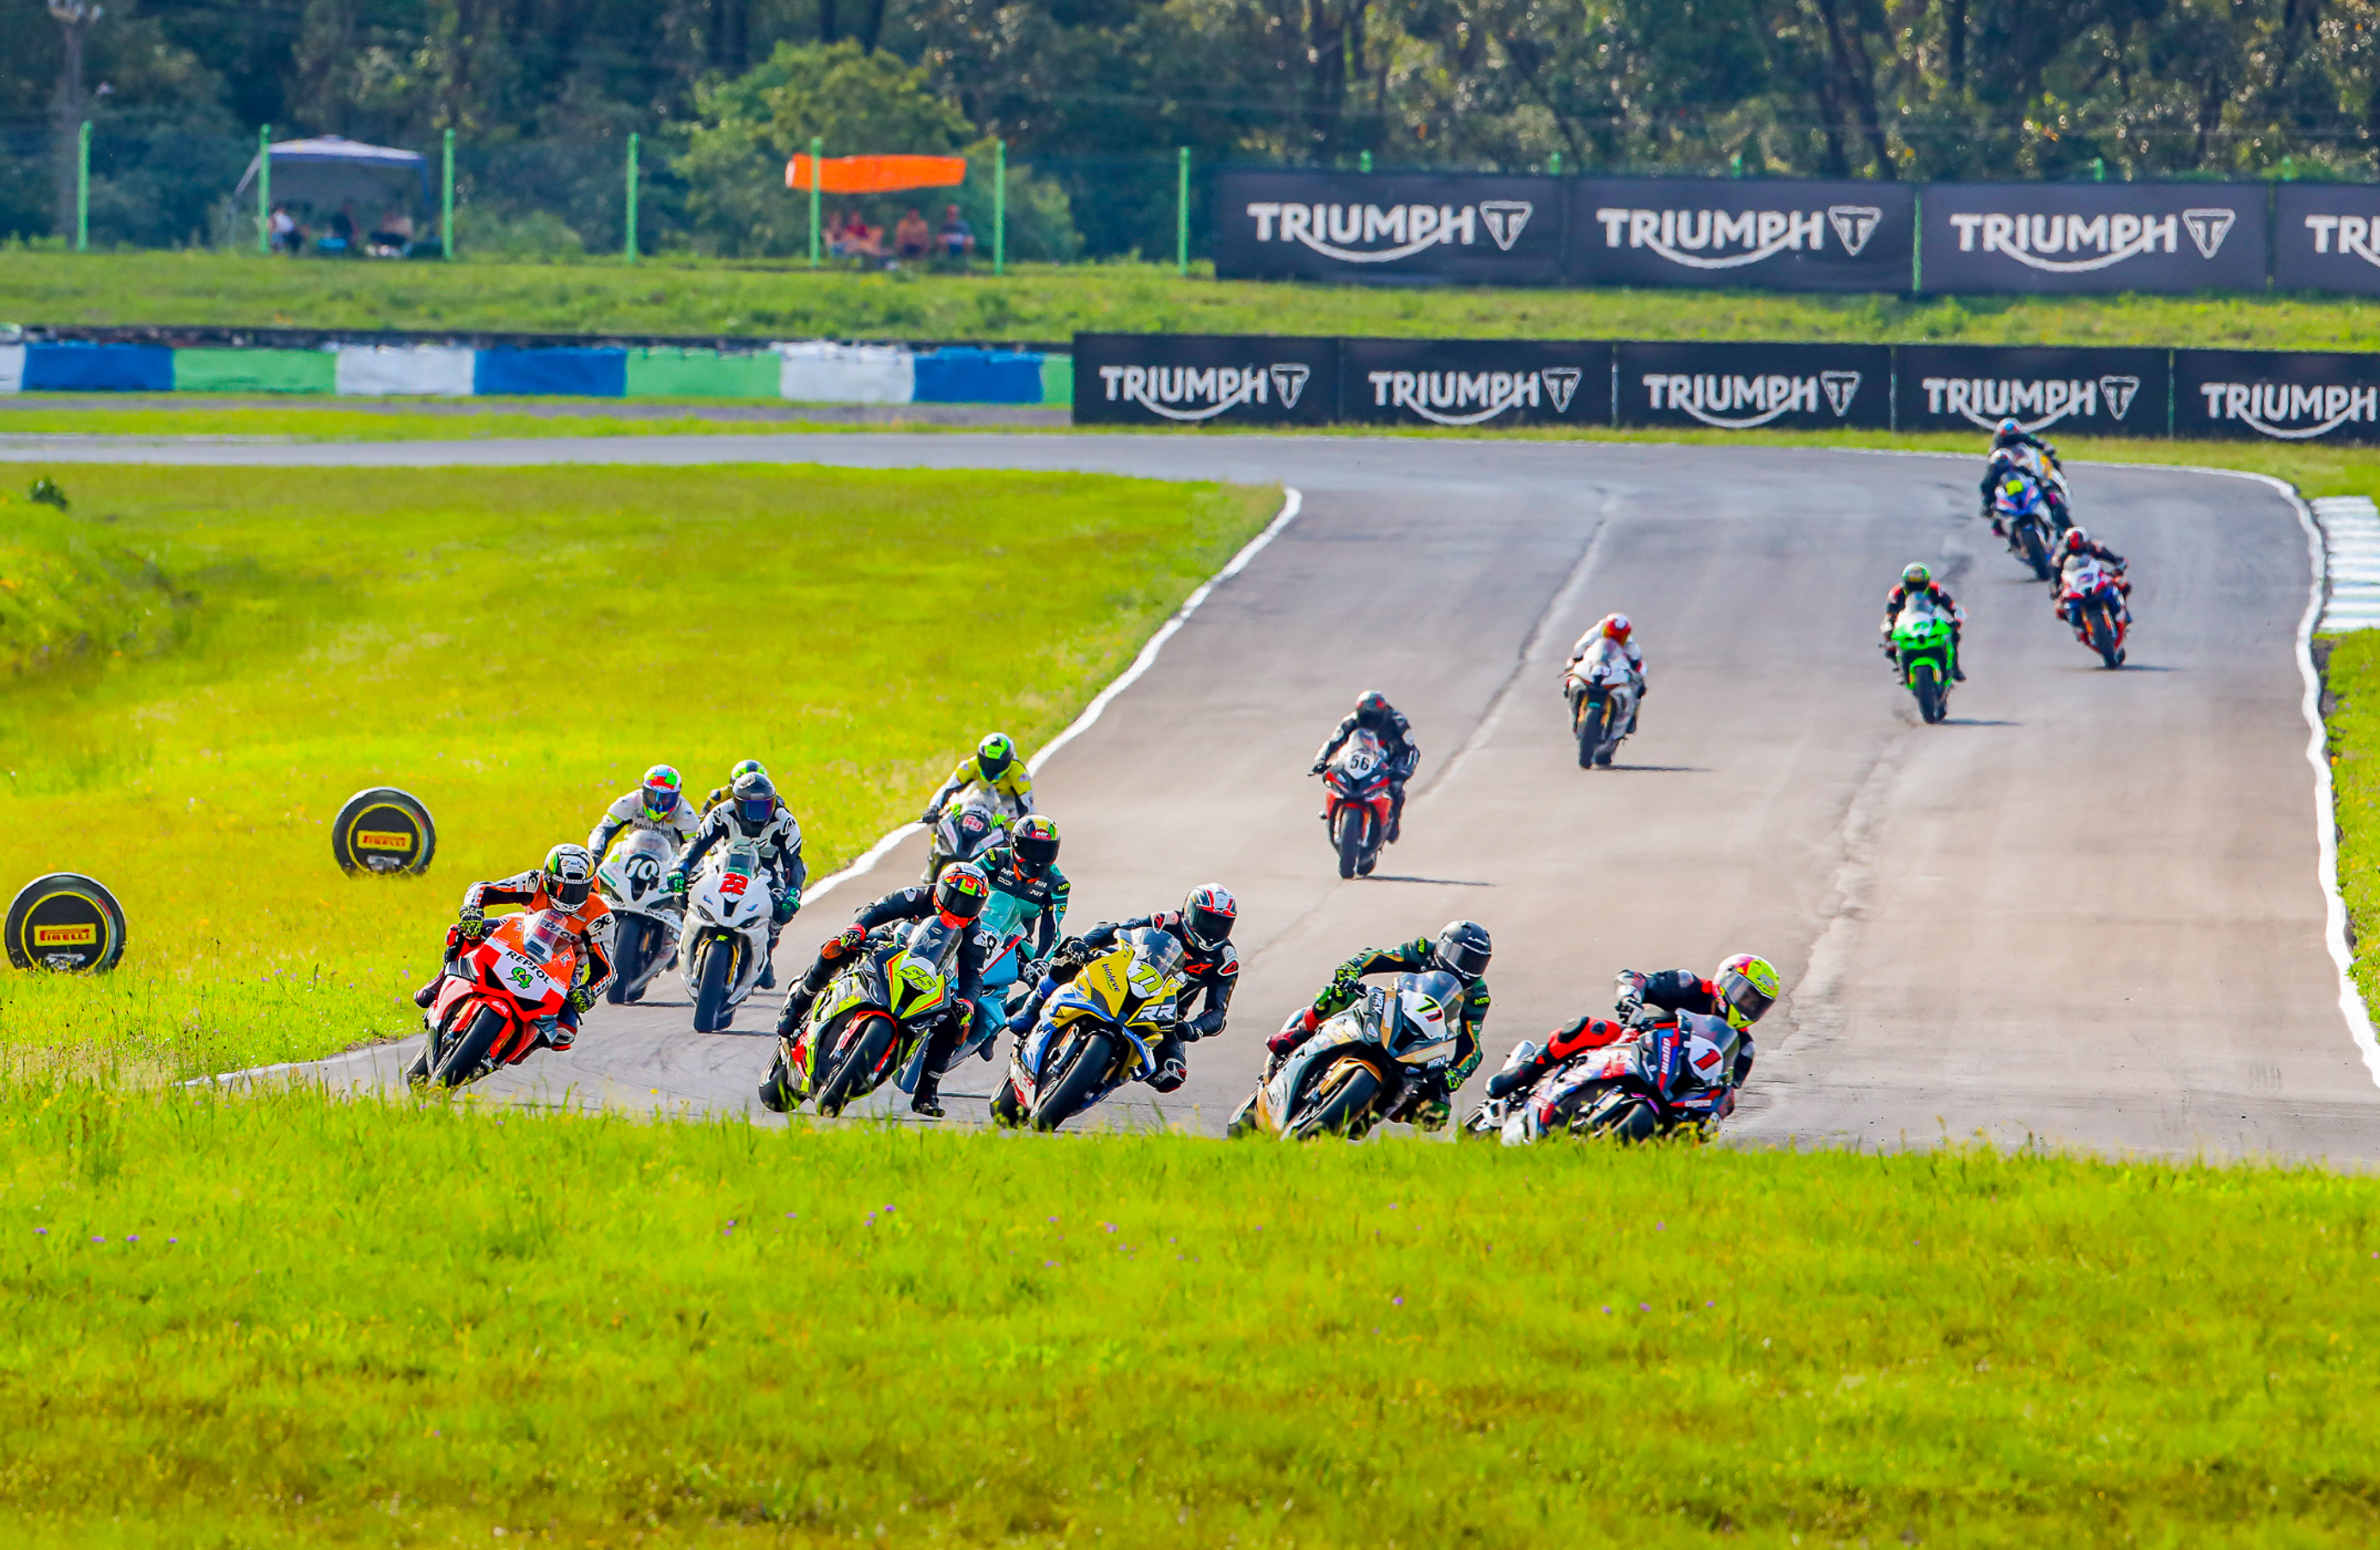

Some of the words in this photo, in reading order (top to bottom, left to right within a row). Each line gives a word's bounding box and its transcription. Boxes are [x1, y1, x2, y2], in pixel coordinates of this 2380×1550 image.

[1247, 202, 1476, 263] TRIUMPH
[1596, 209, 1824, 269] TRIUMPH
[1950, 212, 2178, 273] TRIUMPH
[1099, 364, 1269, 421] TRIUMPH
[1369, 369, 1541, 426] TRIUMPH
[1643, 373, 1818, 430] TRIUMPH
[1921, 376, 2097, 432] TRIUMPH
[2200, 382, 2377, 440] TRIUMPH
[626, 857, 658, 881] 10
[719, 872, 748, 895] 22
[40, 929, 90, 941] PIRELLI
[505, 950, 551, 985] REPSOL
[1102, 963, 1120, 992] bioleve
[1138, 1004, 1177, 1022] RR
[1693, 1048, 1722, 1071] 1
